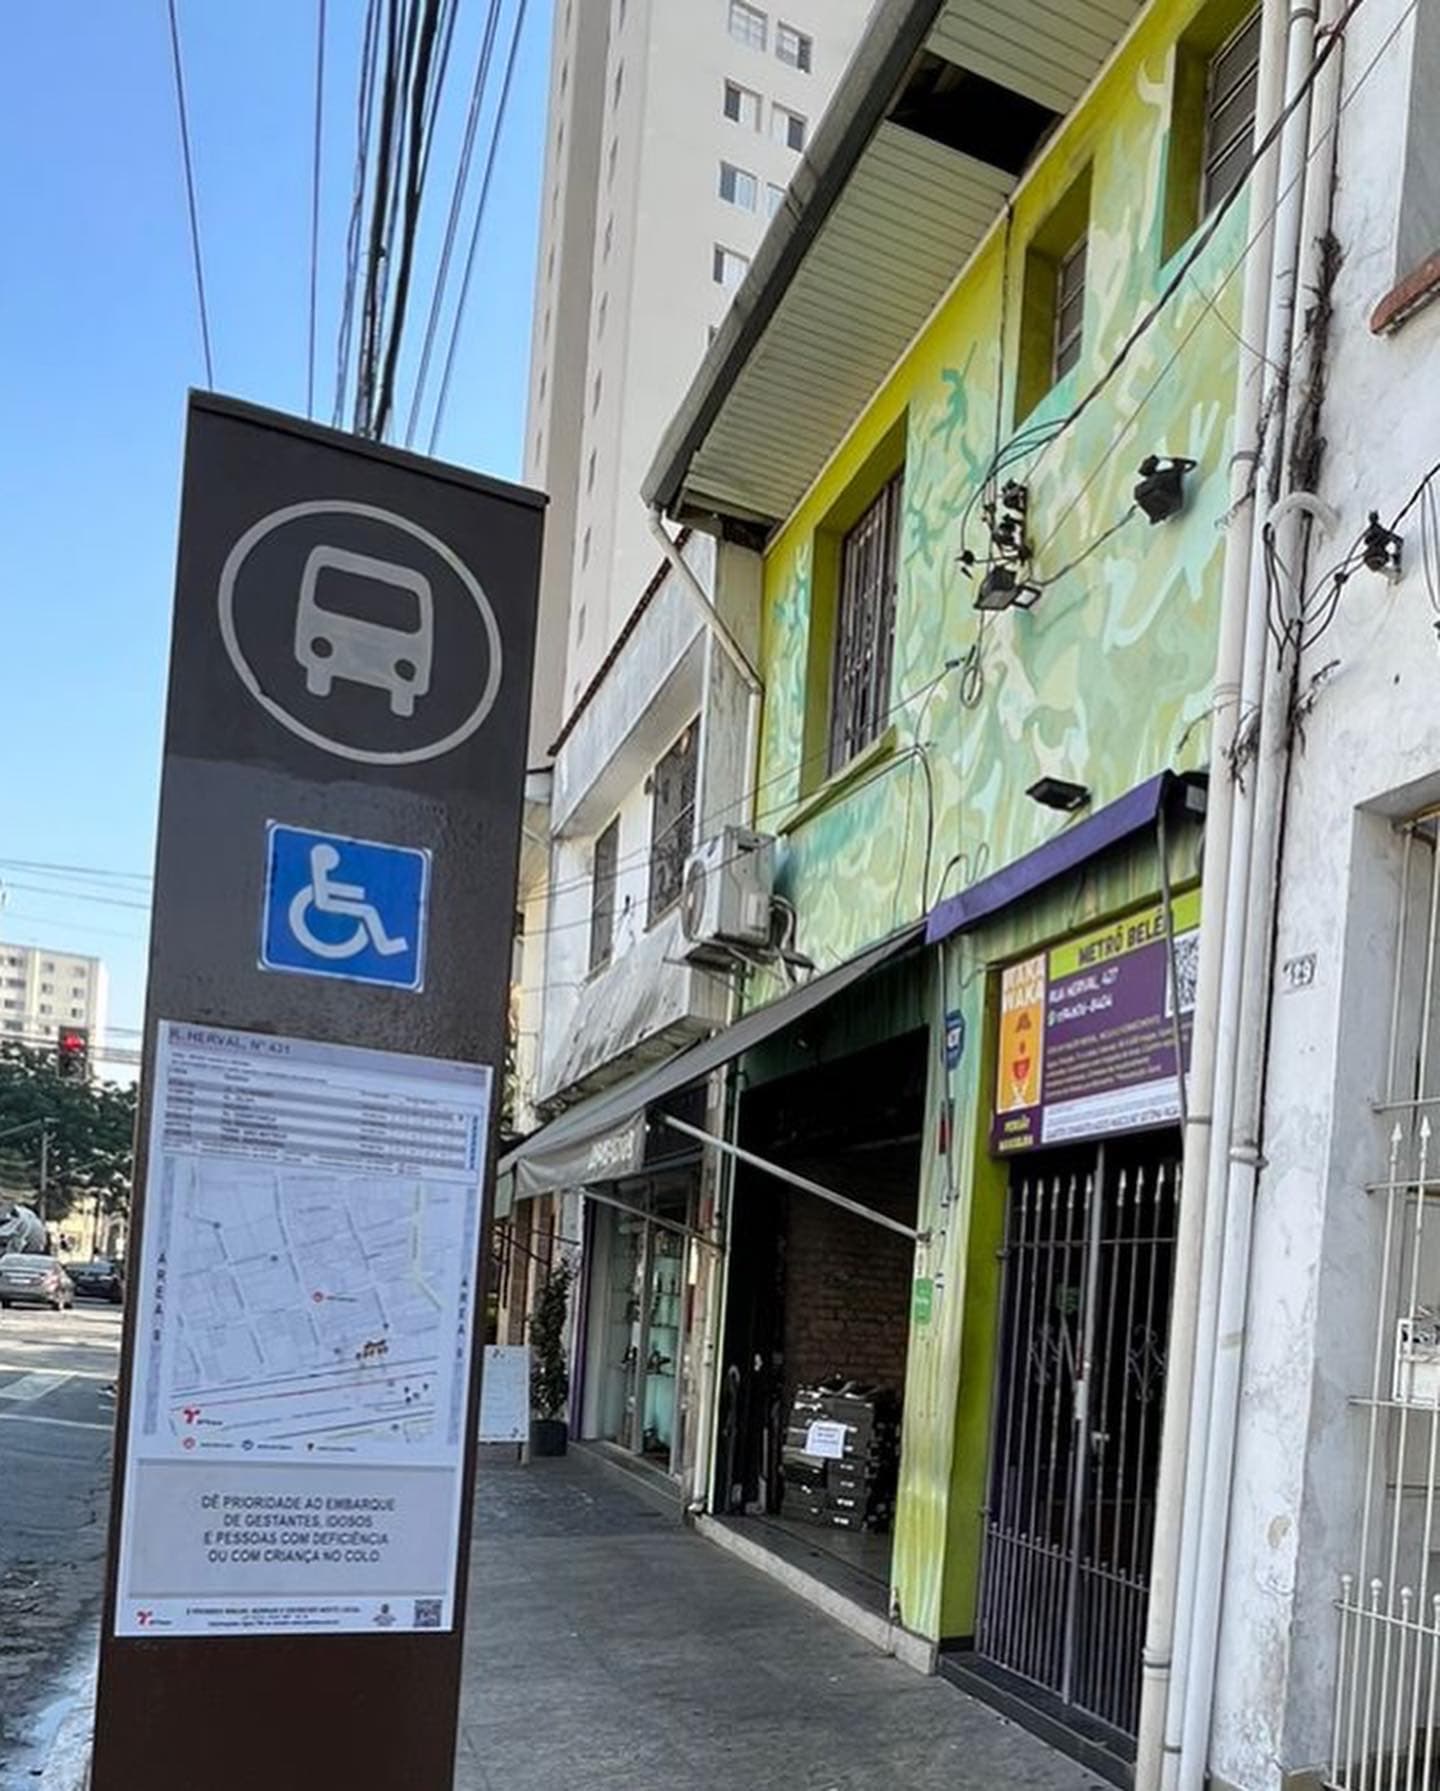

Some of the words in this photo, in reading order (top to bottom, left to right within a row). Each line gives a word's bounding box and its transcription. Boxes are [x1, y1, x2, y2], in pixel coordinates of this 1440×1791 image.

[1078, 925, 1123, 966] METRÔ
[1127, 907, 1168, 949] BELÉ
[201, 1493, 219, 1509] DÊ
[223, 1496, 301, 1510] PRIORIDADE
[304, 1498, 322, 1510] AO
[326, 1497, 395, 1511] EMBARQUE
[223, 1514, 240, 1527] DE
[326, 1515, 373, 1527] IDOSOS
[204, 1531, 212, 1545] E
[216, 1531, 277, 1545] PESSOAS
[281, 1532, 310, 1545] COM
[313, 1530, 388, 1545] DEFICIÊNCIA
[208, 1549, 227, 1562] OU
[231, 1549, 261, 1562] COM
[264, 1549, 319, 1563] CRIANÇA
[323, 1550, 342, 1562] NO
[344, 1550, 380, 1562] COLO
